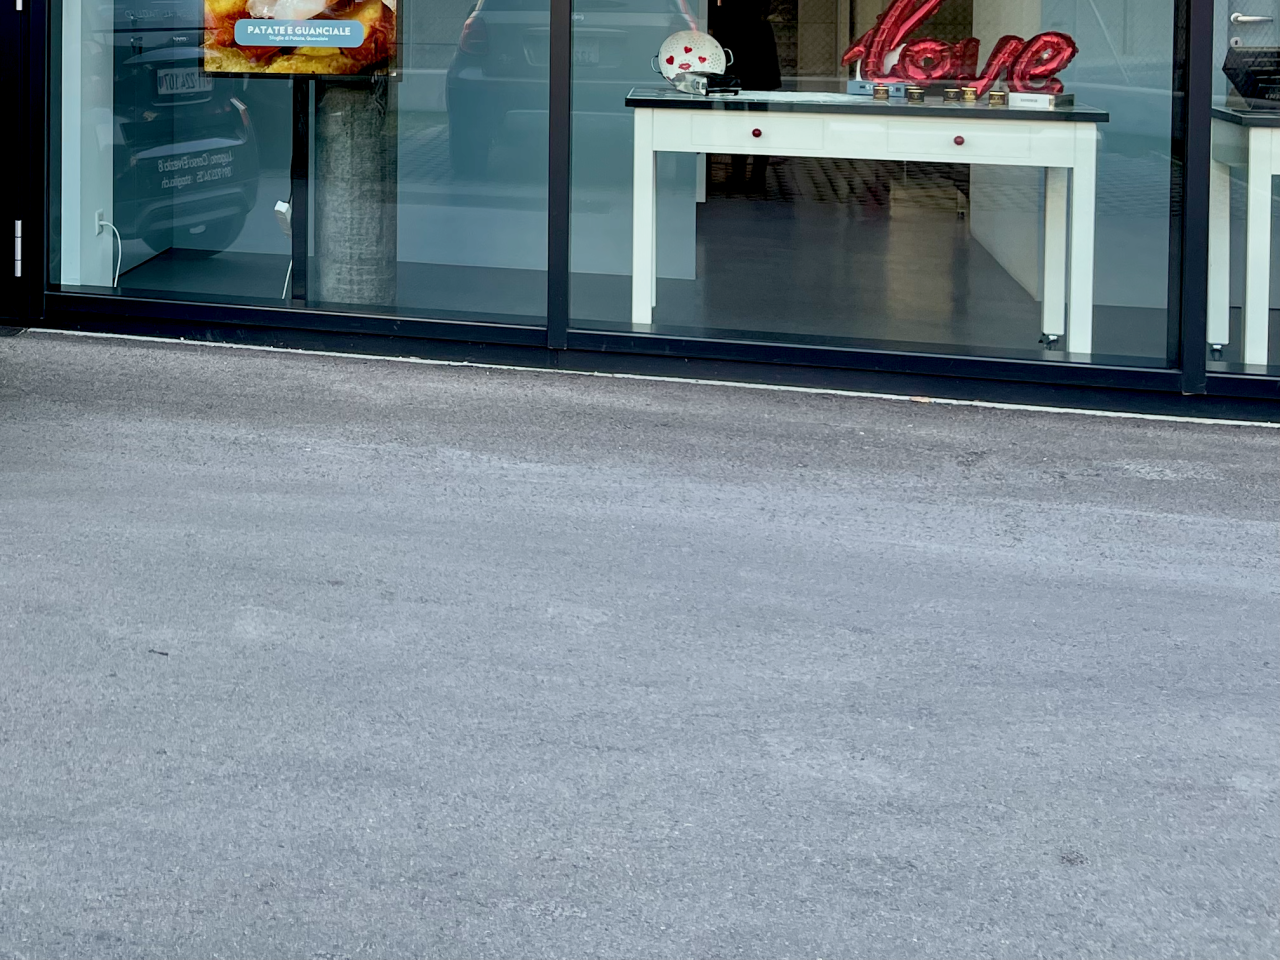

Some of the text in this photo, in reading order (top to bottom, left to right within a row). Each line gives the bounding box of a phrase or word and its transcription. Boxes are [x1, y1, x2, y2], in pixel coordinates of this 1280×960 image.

[247, 25, 351, 36] PATATE E GUANCIALE
